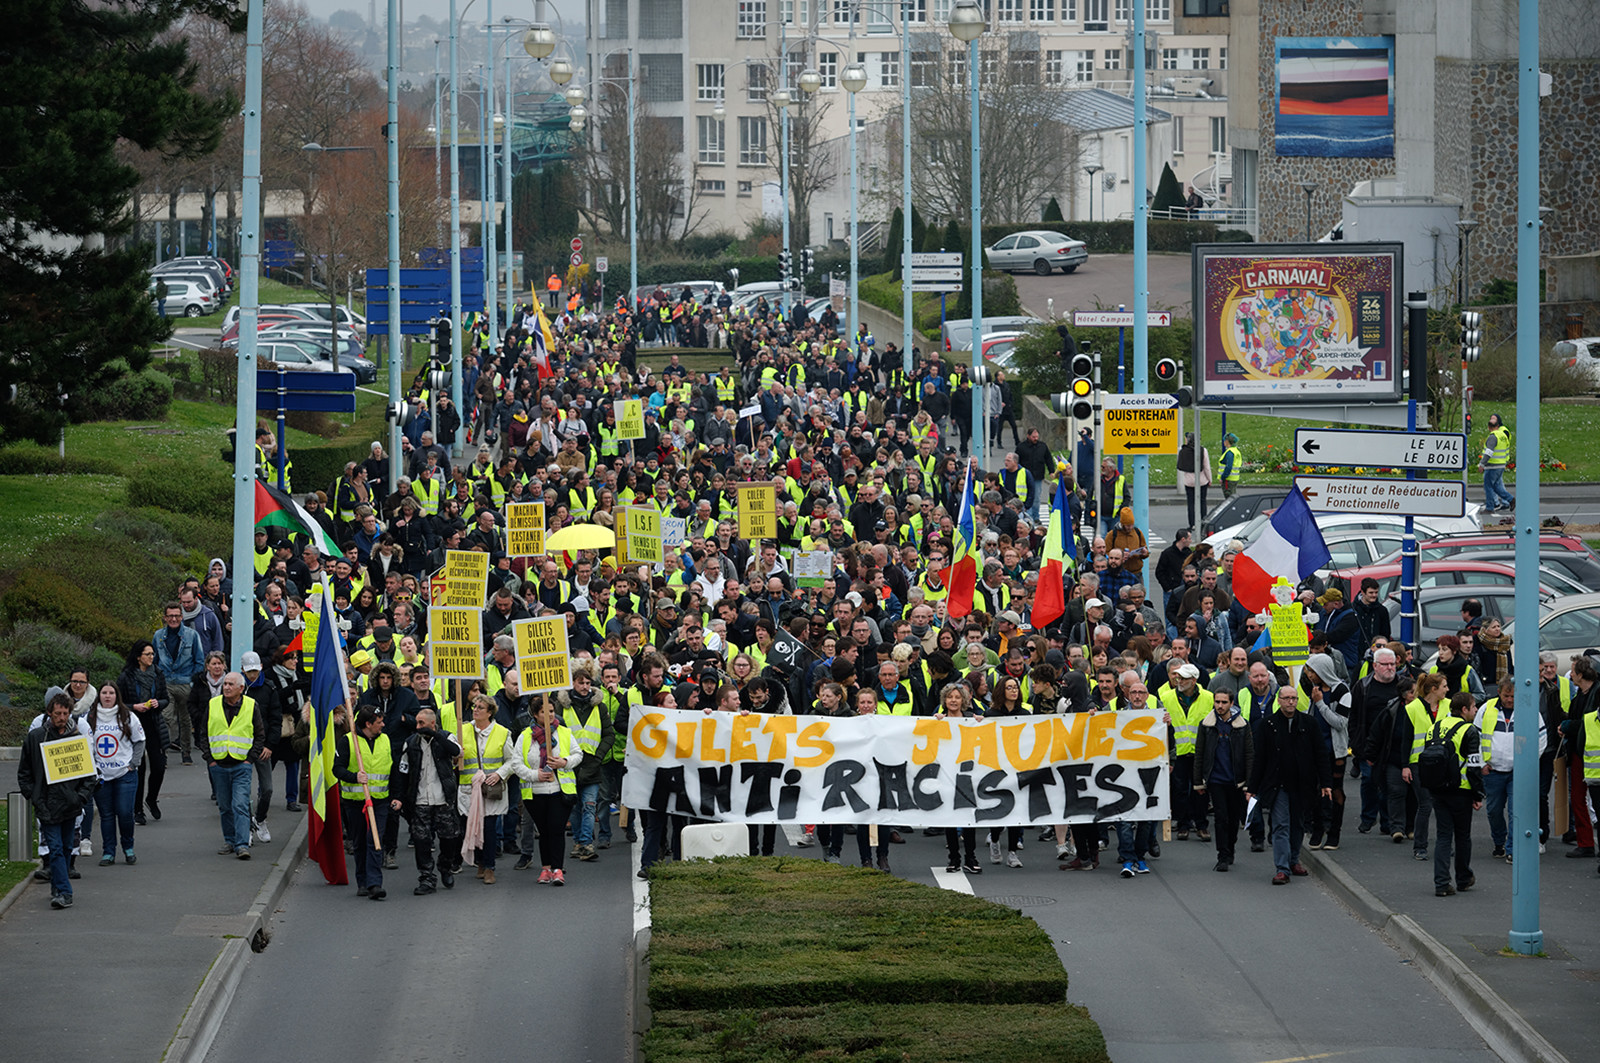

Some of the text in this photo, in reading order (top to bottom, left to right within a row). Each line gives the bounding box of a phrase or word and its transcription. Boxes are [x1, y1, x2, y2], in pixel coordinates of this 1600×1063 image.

[1246, 268, 1326, 288] CARNAVAL
[1362, 299, 1380, 309] 24
[1108, 410, 1175, 421] OUISTREHAM
[622, 429, 640, 437] POUVOIR
[1411, 439, 1458, 451] LE VAL
[1404, 453, 1458, 465] LE BOIS
[1327, 483, 1457, 498] Institut de Reéducation
[750, 500, 764, 510] NOIRE
[1326, 497, 1400, 510] Fonctionnelle
[514, 505, 537, 516] MACRON
[751, 515, 764, 525] GILET
[512, 531, 540, 542] CASTANER
[750, 526, 766, 536] JAUNE
[513, 542, 539, 554] EN ENFER
[634, 536, 657, 549] RENDS LE
[636, 547, 656, 560] POGNON
[449, 567, 479, 578] RÉCUPÉRATION
[448, 596, 477, 606] RÉCUPÉRATION
[442, 611, 467, 625] GILETS
[441, 627, 470, 640] JAUNES
[527, 622, 553, 638] GILETS
[528, 637, 556, 654] JAUNES
[435, 647, 477, 657] POUR UN MONDE
[438, 658, 476, 673] MEILLEUR
[522, 656, 565, 671] POUR UN MONDE
[526, 669, 564, 688] MEILLEUR
[632, 713, 835, 768] GILETS
[912, 712, 1166, 770] JAUNES
[58, 766, 69, 775] MIEUX
